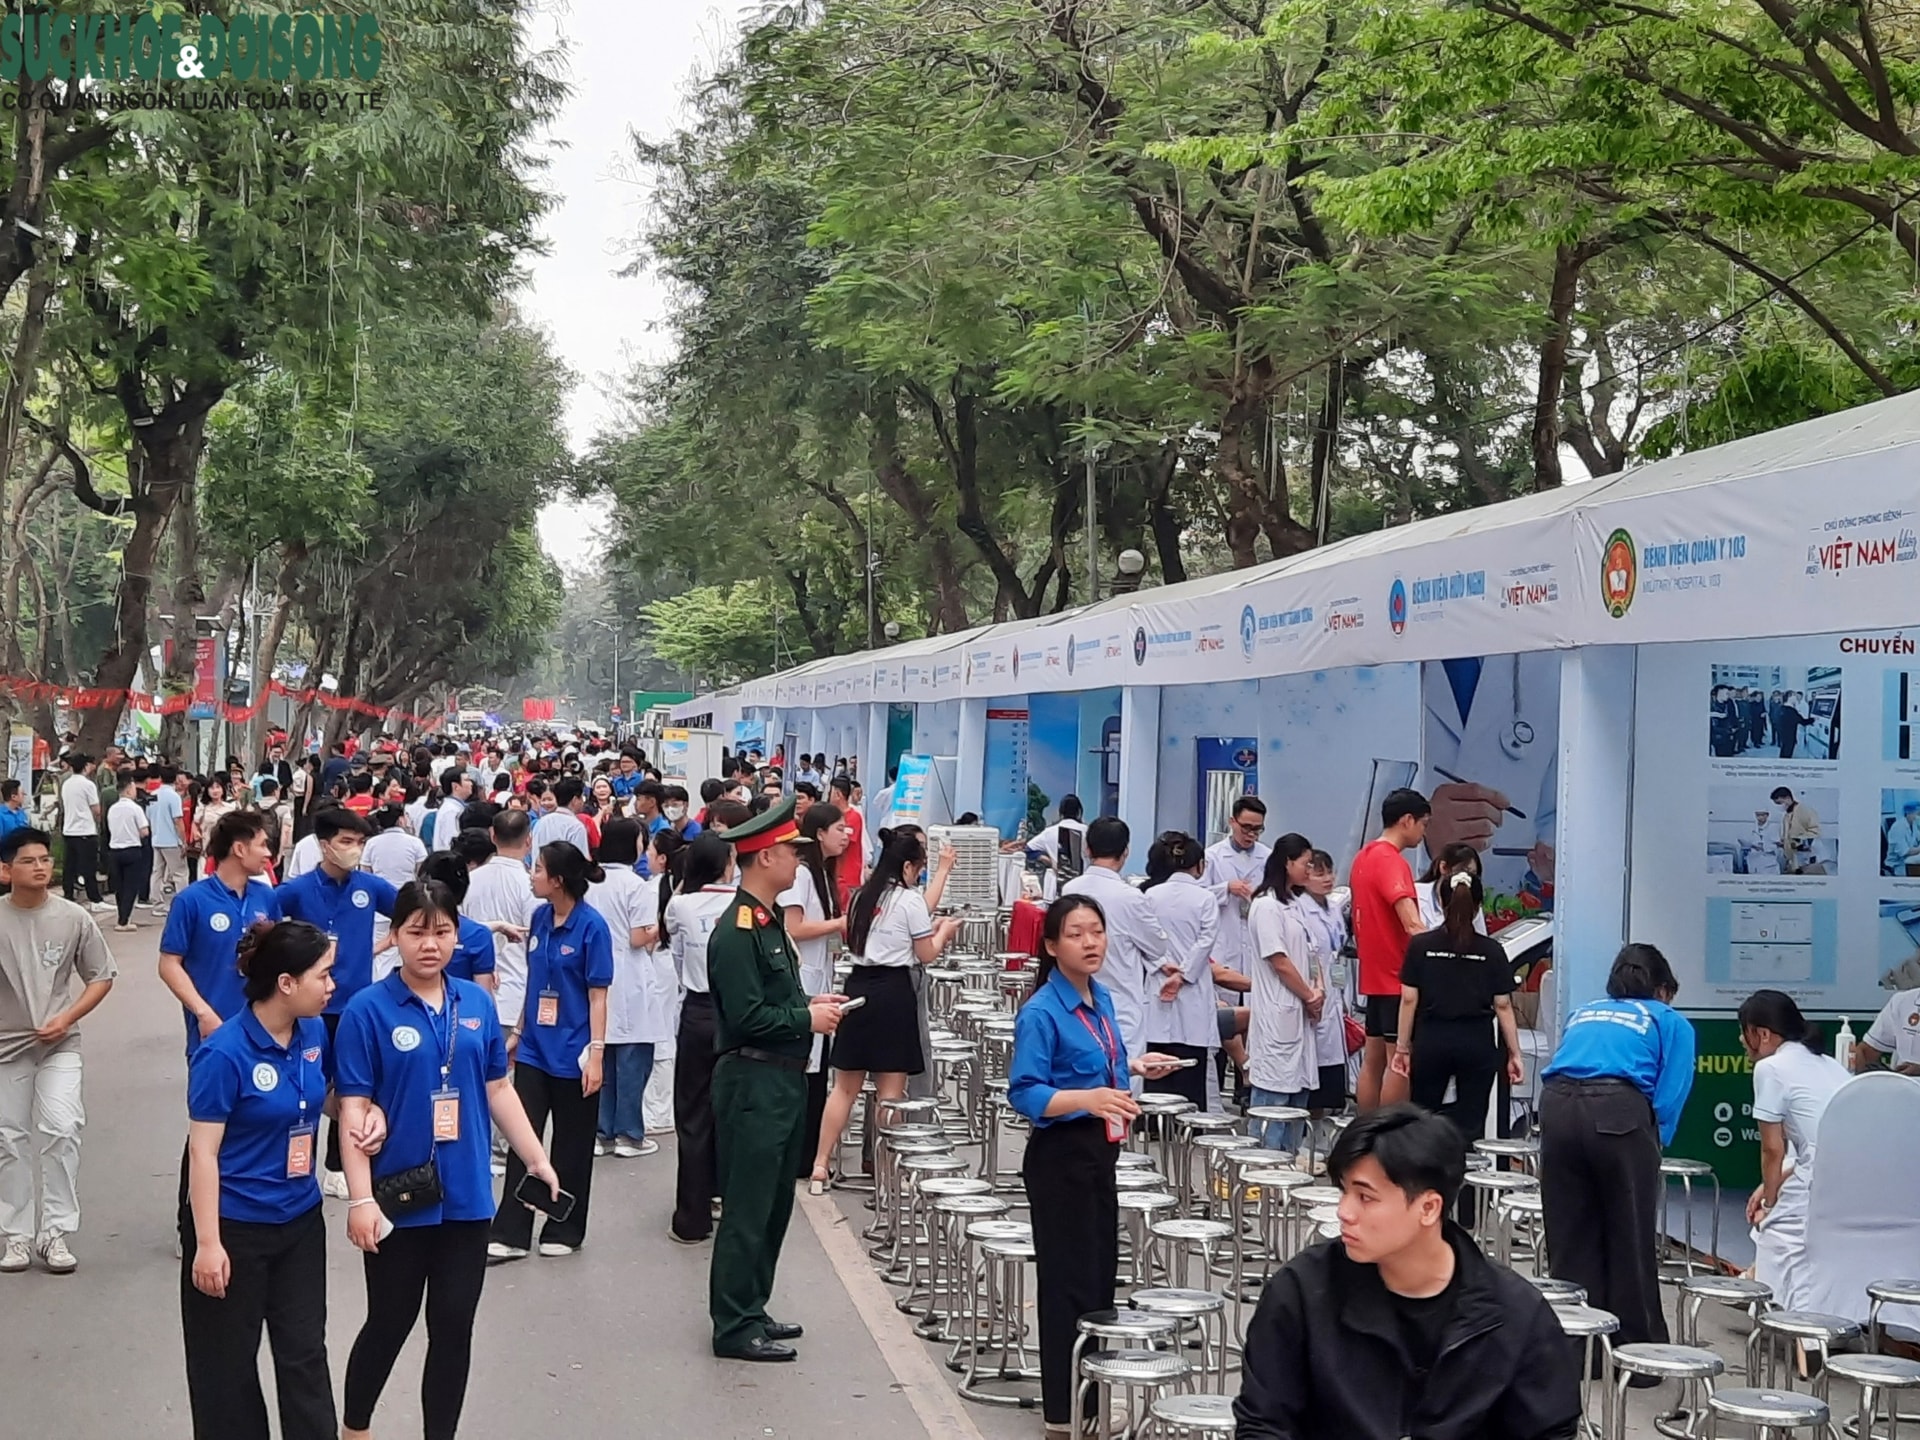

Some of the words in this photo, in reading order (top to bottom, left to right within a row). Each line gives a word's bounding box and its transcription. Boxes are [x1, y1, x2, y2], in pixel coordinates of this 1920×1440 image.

[1643, 542, 1668, 573] BỆNH
[1669, 538, 1690, 570] VIỆN
[1691, 534, 1718, 566] QUÂN
[1719, 537, 1727, 561] Y
[1728, 535, 1747, 559] 103
[1819, 535, 1853, 577] VIỆT
[1856, 536, 1896, 567] NAM
[1506, 580, 1525, 611] VIỆT
[1526, 583, 1548, 605] NAM
[1839, 631, 1915, 655] CHUYỂN
